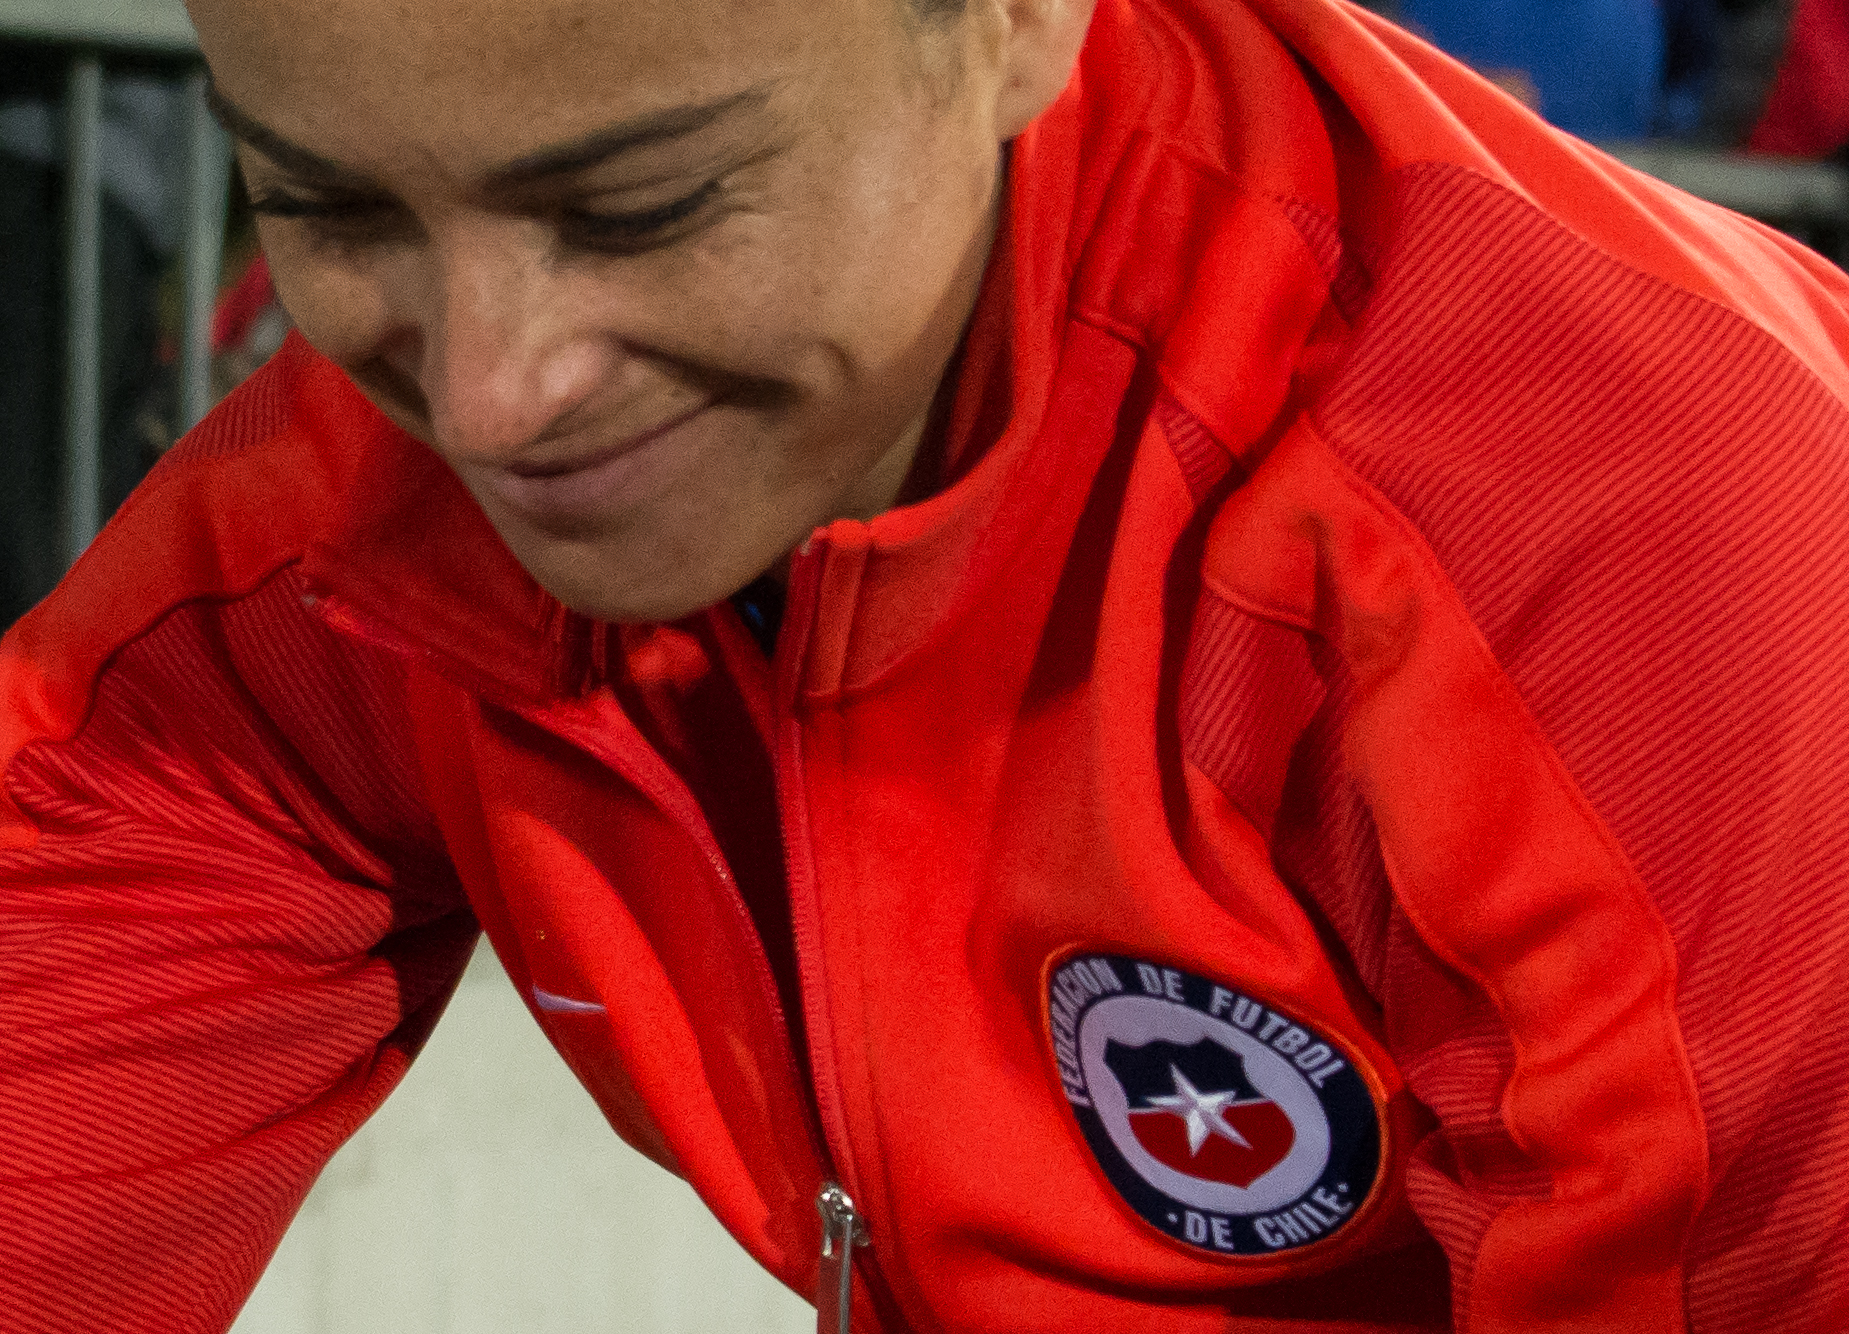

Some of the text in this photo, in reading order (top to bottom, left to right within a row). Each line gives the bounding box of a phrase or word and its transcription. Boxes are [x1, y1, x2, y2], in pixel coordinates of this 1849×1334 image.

[1137, 963, 1187, 1002] DE
[1208, 986, 1347, 1089] FUTBOL
[1183, 1185, 1353, 1250] DE CHILE
